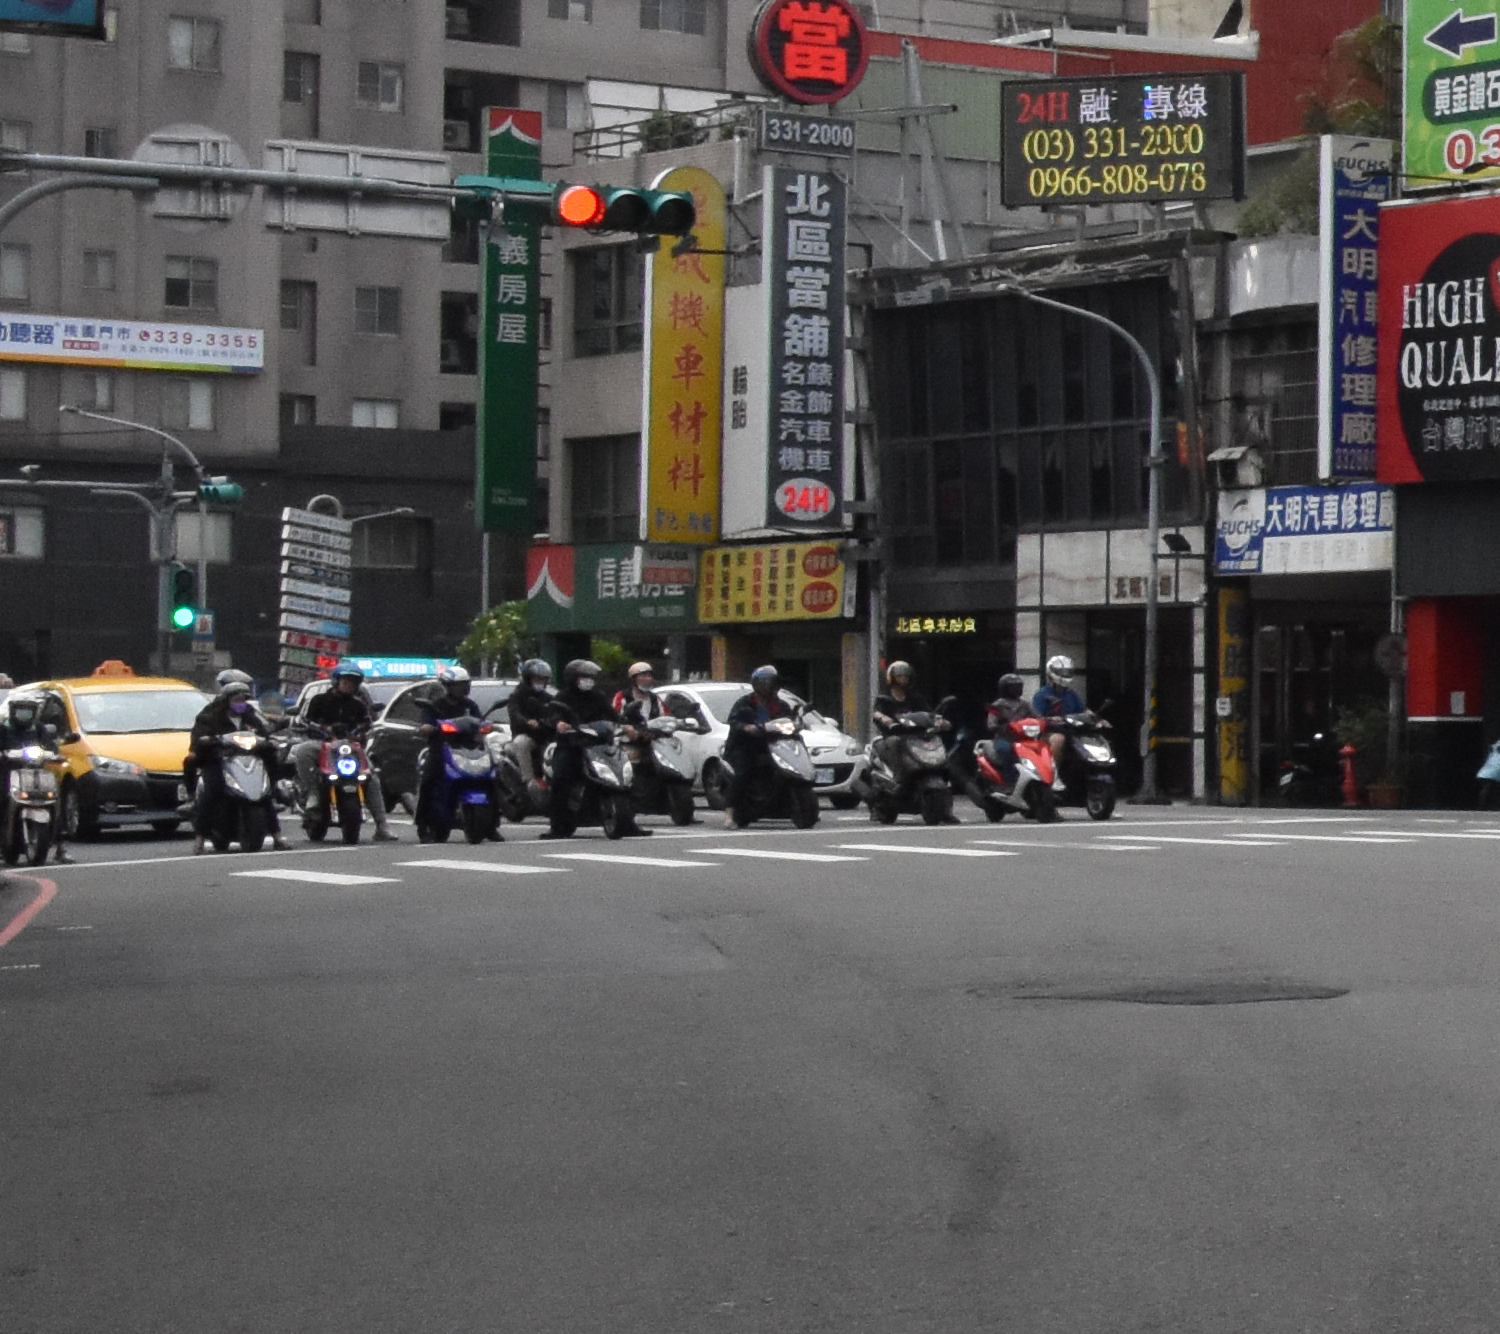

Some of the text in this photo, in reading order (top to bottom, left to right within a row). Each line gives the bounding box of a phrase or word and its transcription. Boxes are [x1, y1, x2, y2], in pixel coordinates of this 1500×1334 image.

[778, 0, 851, 85] 當
[1016, 91, 1069, 124] 24H
[769, 119, 853, 148] 331-2000
[1023, 124, 1204, 163] (03) 331-2000
[1029, 162, 1206, 197] 0966-808-078
[784, 174, 831, 358] 北區當舖
[496, 233, 528, 344] 義房屋
[1402, 276, 1486, 329] HIGH
[154, 329, 257, 349] 339-3355
[783, 486, 830, 512] 24H
